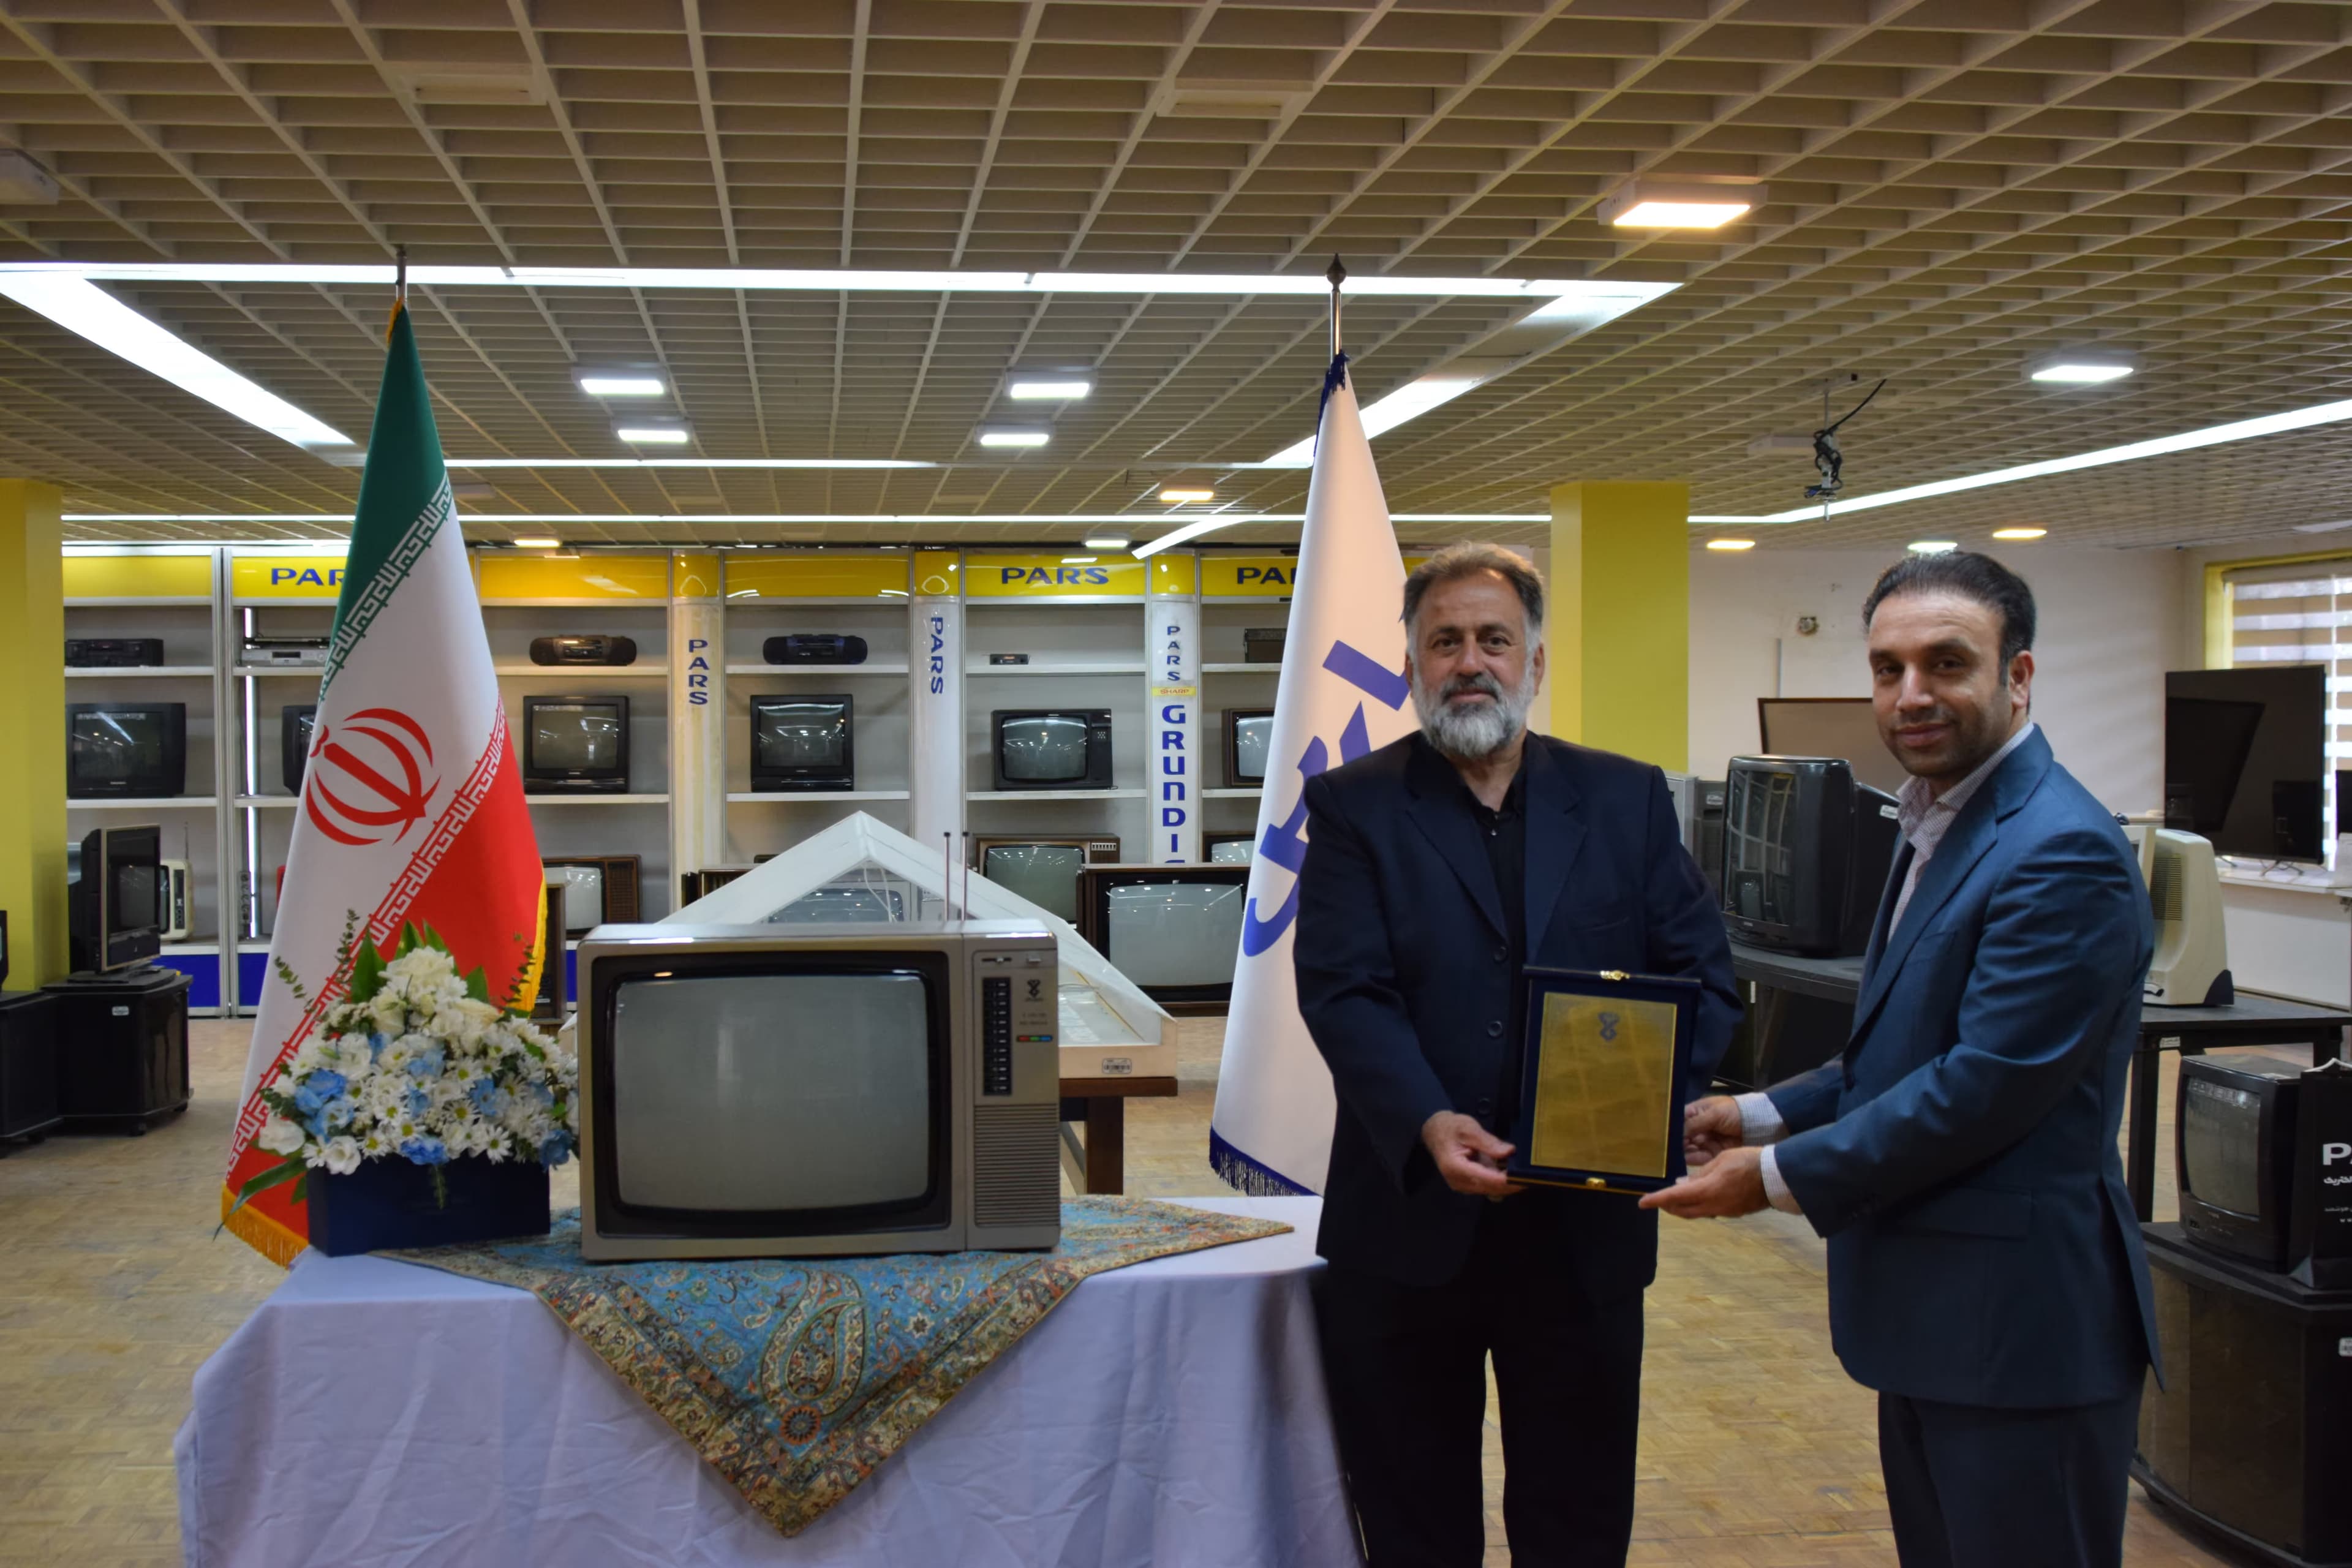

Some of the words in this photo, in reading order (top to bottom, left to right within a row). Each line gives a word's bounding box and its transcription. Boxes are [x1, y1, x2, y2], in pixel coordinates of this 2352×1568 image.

[272, 568, 347, 586] PAR
[1001, 567, 1109, 585] PARS
[1237, 568, 1297, 585] PA
[688, 639, 708, 705] PARS
[930, 617, 944, 695] PARS
[1167, 625, 1181, 682] PARS
[1161, 705, 1186, 863] GRUNDI
[2323, 1142, 2352, 1166] P
